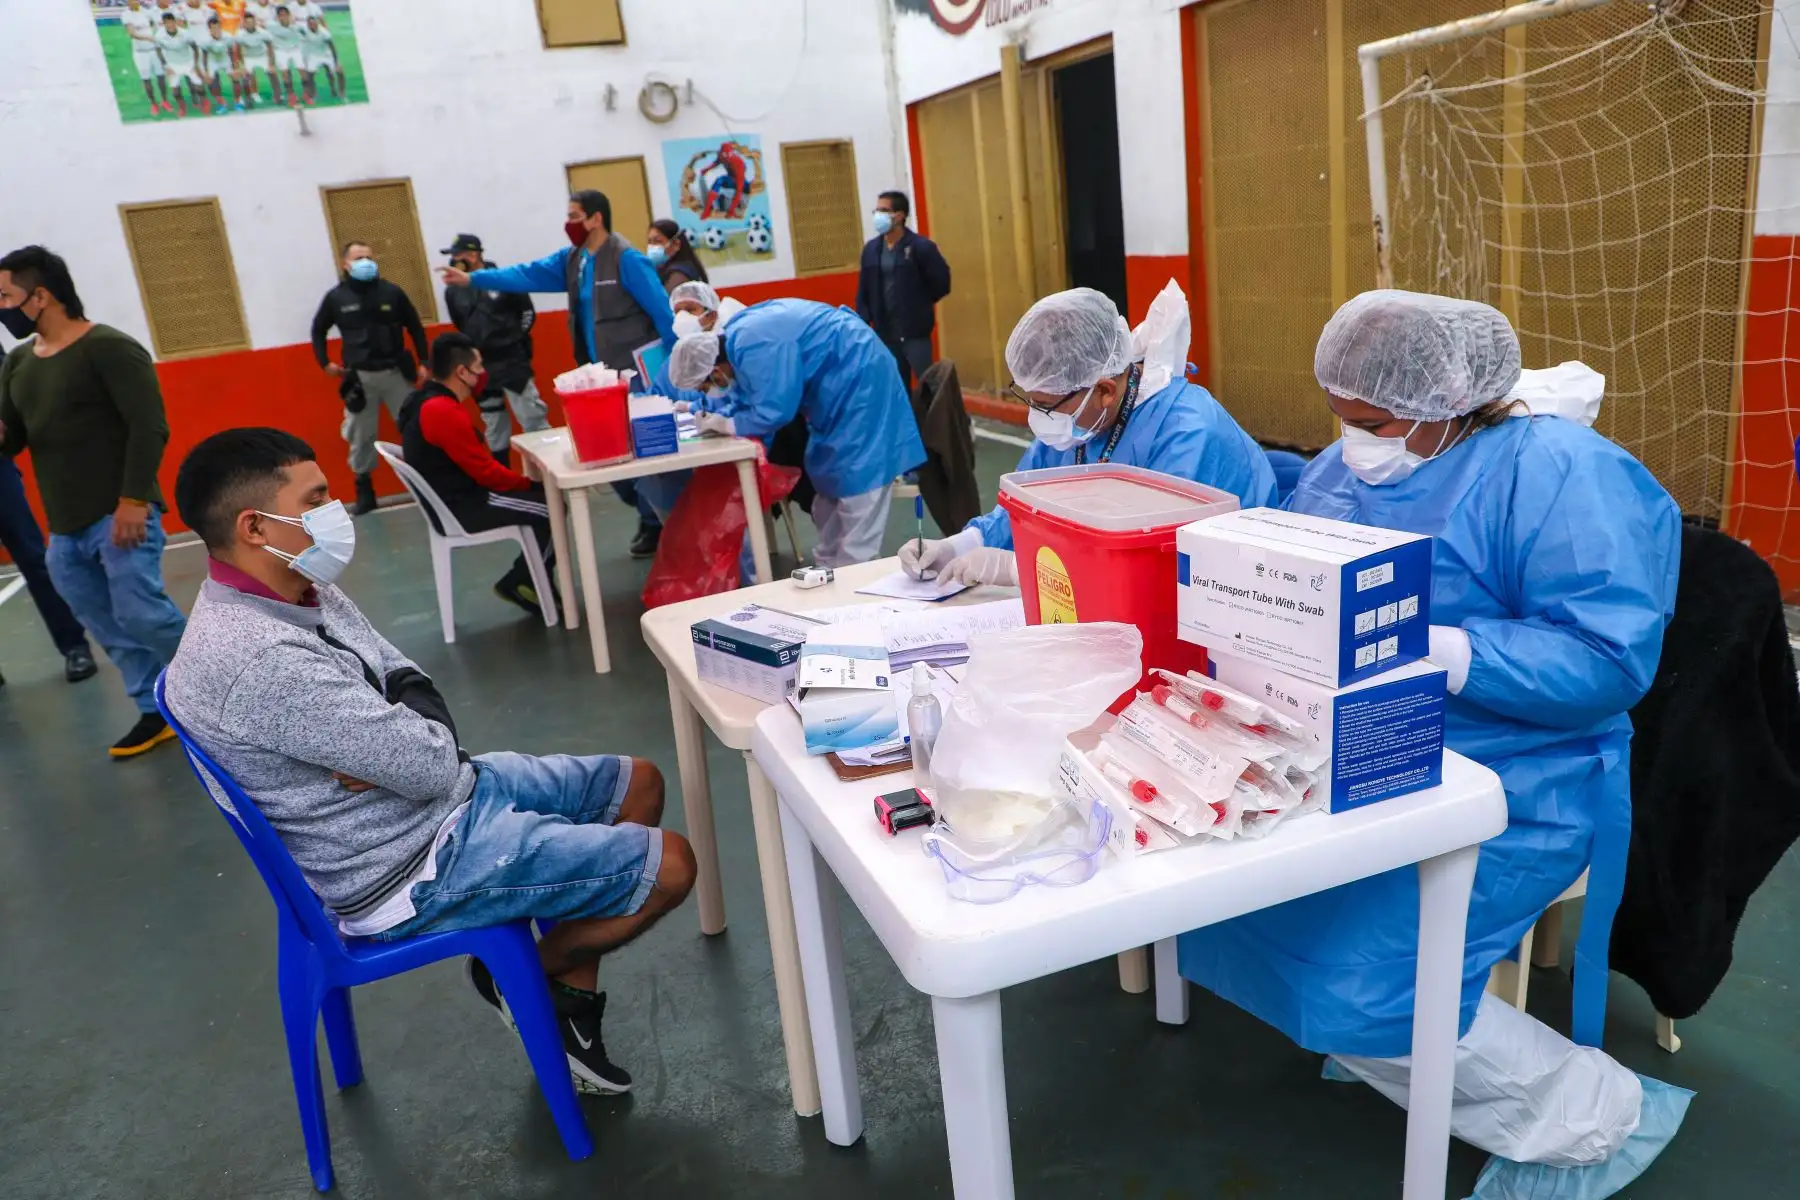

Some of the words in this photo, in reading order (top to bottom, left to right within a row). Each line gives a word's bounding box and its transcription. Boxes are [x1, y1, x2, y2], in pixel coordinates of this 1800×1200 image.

[1106, 424, 1123, 454] THOR
[1037, 570, 1071, 597] PELIGRO
[1192, 574, 1210, 588] Viral
[1211, 580, 1250, 599] Transport
[1252, 590, 1273, 605] Tube
[1275, 596, 1296, 610] With
[1298, 602, 1324, 617] Swab
